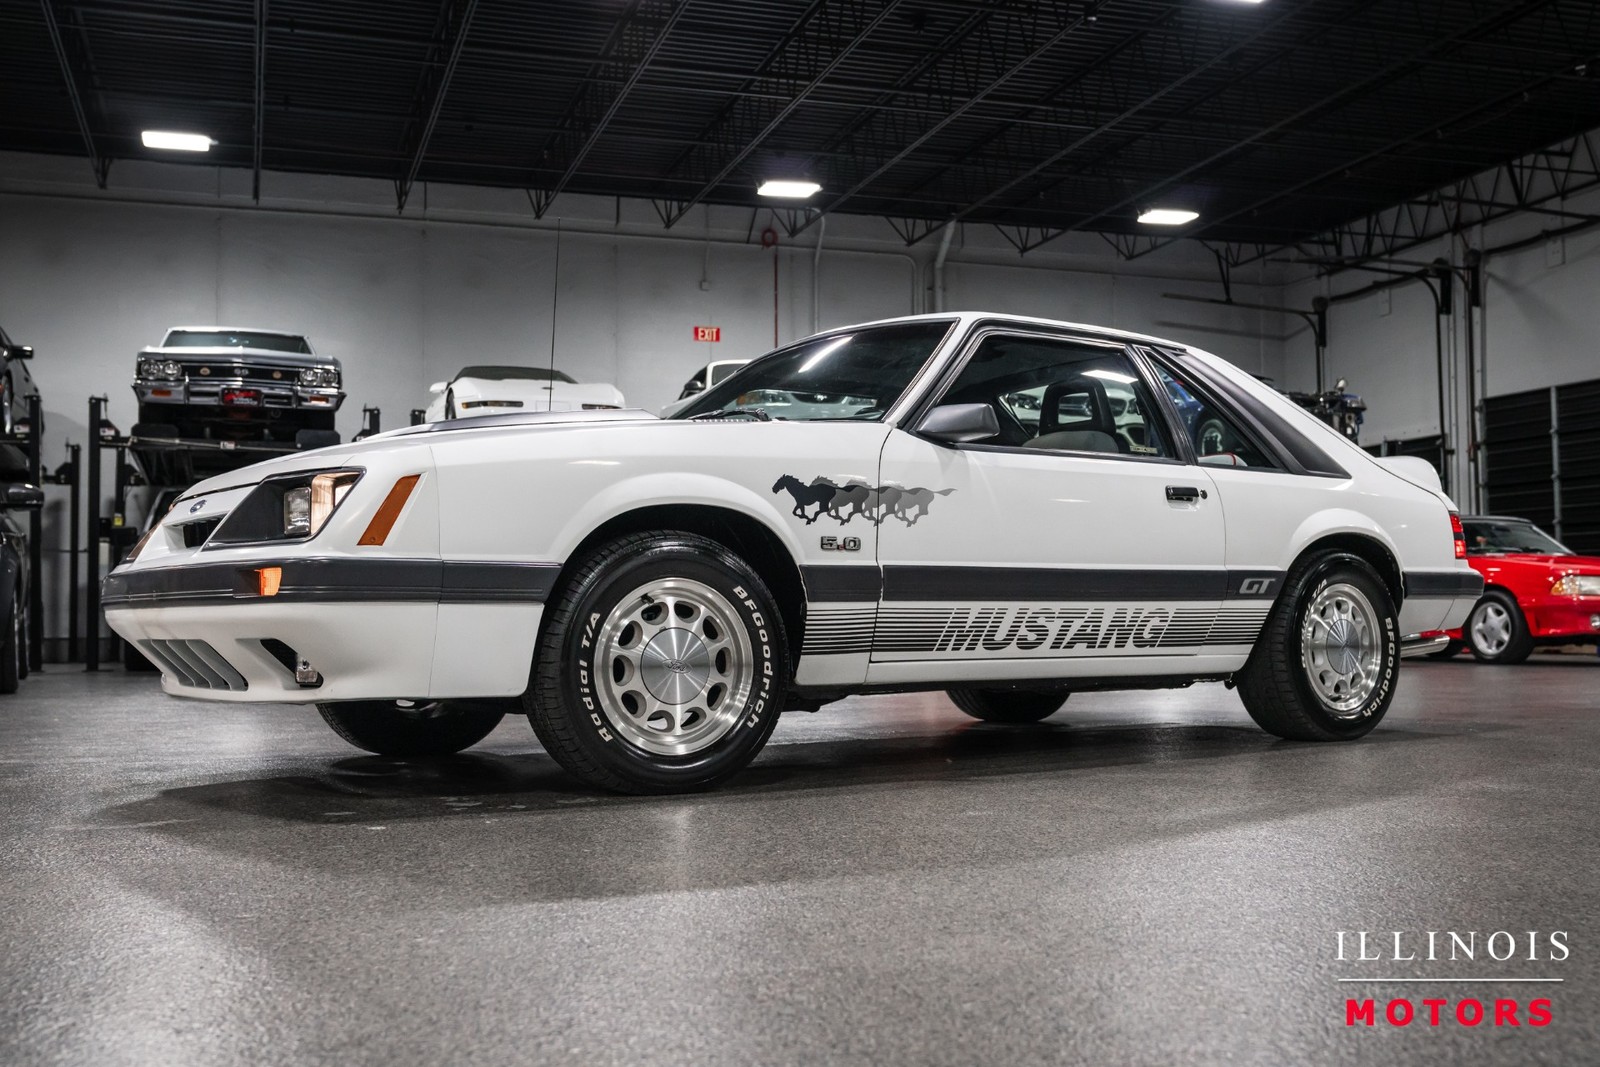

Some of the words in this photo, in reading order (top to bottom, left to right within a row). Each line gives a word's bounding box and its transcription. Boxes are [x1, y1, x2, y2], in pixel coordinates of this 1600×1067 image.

[698, 328, 717, 341] EXIT
[820, 536, 861, 551] 5.0
[1239, 578, 1276, 594] GT
[581, 612, 601, 649] T/A
[935, 607, 1171, 651] MUSTANG
[732, 585, 774, 729] BFGoodrich
[1362, 617, 1395, 718] BFGoodrich
[579, 659, 614, 742] Radial
